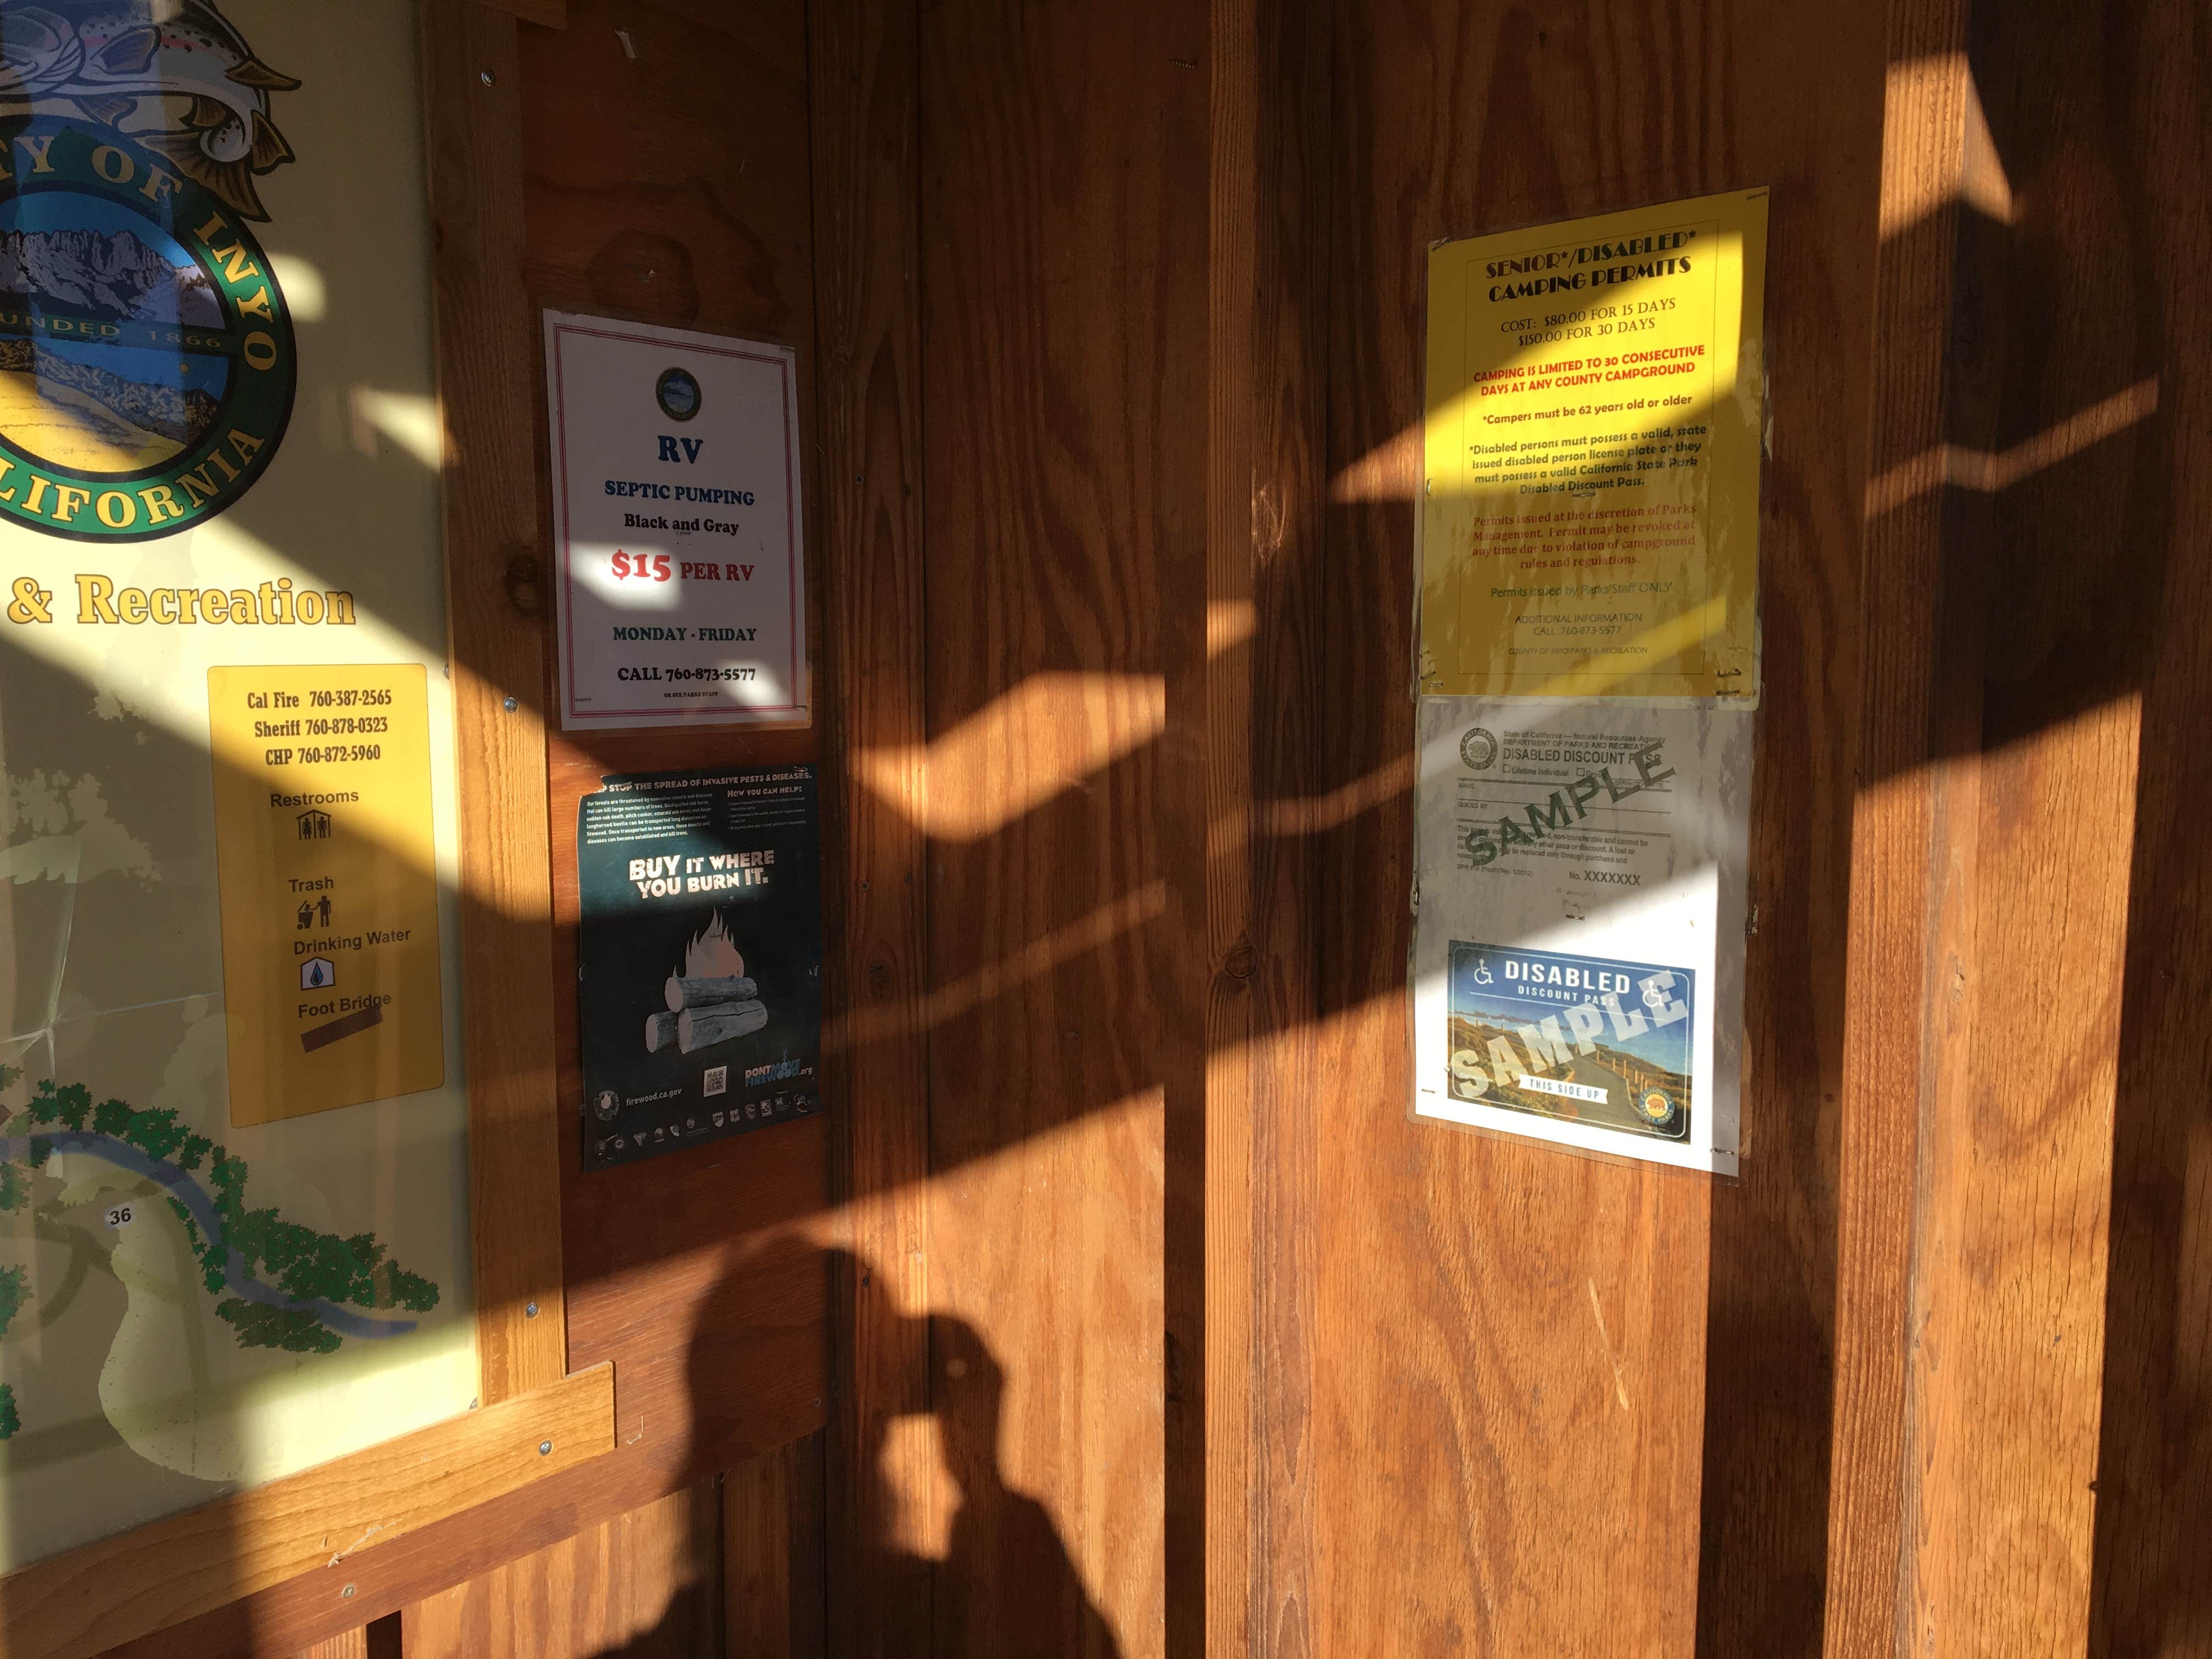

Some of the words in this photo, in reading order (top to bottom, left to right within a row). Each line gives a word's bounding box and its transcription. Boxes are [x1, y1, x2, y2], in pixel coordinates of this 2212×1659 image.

[91, 145, 183, 202] OF
[193, 211, 278, 371] INYO
[1489, 272, 1586, 302] CAMPING
[1592, 257, 1692, 286] PERMITS
[1501, 318, 1536, 334] COST:
[1544, 311, 1586, 327] $80.00
[1590, 306, 1616, 320] FOR
[1622, 304, 1634, 316] 15
[1638, 298, 1677, 314] DAYS
[146, 331, 221, 347] 1866
[1519, 330, 1562, 346] $150.00
[1567, 326, 1592, 340] FOR
[1598, 324, 1612, 336] 30
[1618, 318, 1655, 332] DAYS
[1474, 367, 1524, 382] CAMPING
[1527, 366, 1536, 376] IS
[1538, 360, 1583, 375] LIMITED
[1587, 358, 1601, 369] TO
[1605, 356, 1618, 367] 30
[1622, 345, 1705, 365] CONSECUTIVE
[1481, 382, 1509, 396] DAYS
[1511, 382, 1525, 393] AT
[1528, 379, 1552, 392] ANY
[1555, 374, 1602, 390] COUNTY
[1605, 362, 1695, 383] CAMPGROUND
[1535, 409, 1560, 420] must
[1563, 407, 1576, 417] be
[1579, 405, 1592, 415] 62
[1594, 403, 1624, 416] years
[1627, 399, 1645, 411] old
[1647, 398, 1660, 408] or
[1662, 394, 1692, 407] older
[657, 435, 703, 464] RV
[1521, 439, 1559, 454] persons
[1561, 436, 1588, 448] must
[1591, 432, 1628, 447] possess
[1632, 432, 1638, 440] a
[1641, 427, 1674, 441] valid,
[1677, 425, 1707, 437] state
[1472, 456, 1502, 470] issued
[1505, 453, 1549, 467] disabled
[1551, 451, 1587, 466] person
[1589, 447, 1625, 460] license
[1627, 444, 1657, 459] plate
[1660, 444, 1673, 453] or
[1675, 441, 1702, 455] they
[1475, 473, 1500, 484] must
[1502, 470, 1538, 484] possess
[1540, 470, 1547, 478] a
[1550, 466, 1577, 478] valid
[1580, 461, 1633, 476] California
[1637, 459, 1666, 471] State
[1669, 456, 1698, 469] Park
[605, 480, 670, 499] SEPTIC
[675, 486, 754, 506] PUMPING
[1520, 482, 1565, 495] Disabled
[1568, 478, 1614, 492] Discount
[1617, 476, 1645, 488] Pass.
[624, 514, 668, 529] Black
[673, 516, 699, 532] and
[704, 519, 739, 535] Gray
[1474, 514, 1514, 527] Permits
[1517, 510, 1551, 524] issued
[1554, 511, 1565, 522] at
[1567, 509, 1584, 521] the
[1588, 505, 1645, 520] discretion
[1649, 503, 1661, 515] of
[1662, 503, 1696, 515] Parks
[611, 549, 671, 582] $15
[680, 562, 720, 580] PER
[726, 564, 754, 581] RV
[1520, 557, 1548, 571] rules
[1550, 556, 1570, 568] and
[1572, 553, 1640, 569] regulations.
[7, 577, 53, 624] &
[75, 574, 356, 625] Recreation
[1491, 586, 1527, 598] Permits
[1530, 585, 1561, 597] issued
[1565, 585, 1578, 598] by
[1639, 581, 1672, 594] ONLY
[1515, 613, 1572, 625] ADDITIONAL
[1575, 612, 1642, 623] INFORMATION
[613, 627, 687, 641] MONDAY
[698, 628, 757, 641] FRIDAY
[1534, 626, 1556, 636] CALL
[617, 667, 662, 681] CALL
[665, 668, 755, 681] 760-873-5577
[247, 692, 268, 708] Cal
[274, 691, 299, 708] Fire
[309, 689, 392, 707] 760-387-2565
[255, 719, 301, 737] Sheriff
[306, 716, 388, 736] 760-878-0323
[266, 749, 292, 765] CHP
[298, 744, 381, 764] 760-872-5960
[1503, 748, 1560, 761] DISABLED
[1564, 749, 1624, 764] DISCOUNT
[608, 782, 632, 793] STOP
[635, 782, 652, 791] THE
[654, 779, 688, 789] SPREAD
[690, 778, 701, 787] OF
[703, 776, 738, 786] INVASIVE
[740, 775, 764, 783] PESTS
[772, 771, 812, 781] DISEASES.
[727, 789, 744, 798] HOW
[747, 788, 760, 797] YOU
[780, 786, 802, 794] HELP:
[270, 790, 359, 808] Restrooms
[1465, 742, 1675, 867] SAMPLE
[629, 855, 680, 881] BUY
[686, 857, 704, 873] IT
[709, 850, 775, 871] WHERE
[289, 877, 334, 893] Trash
[636, 877, 681, 899] YOU
[687, 872, 740, 893] BURN
[744, 867, 768, 885] IT.
[1584, 870, 1641, 886] XXXXXXX
[294, 935, 362, 955] Drinking
[367, 929, 411, 945] Water
[1505, 960, 1630, 994] DISABLED
[298, 1001, 335, 1018] Foot
[340, 993, 391, 1012] Bridge
[1518, 985, 1577, 1002] DISCOUNT
[1584, 994, 1615, 1007] PASS
[1450, 969, 1689, 1097] SAMPLE
[626, 1087, 682, 1107] firewood.ca.gov
[1530, 1078, 1552, 1092] THIS
[1558, 1082, 1581, 1096] SIDE
[1587, 1088, 1599, 1099] UP
[110, 1207, 131, 1225] 36
